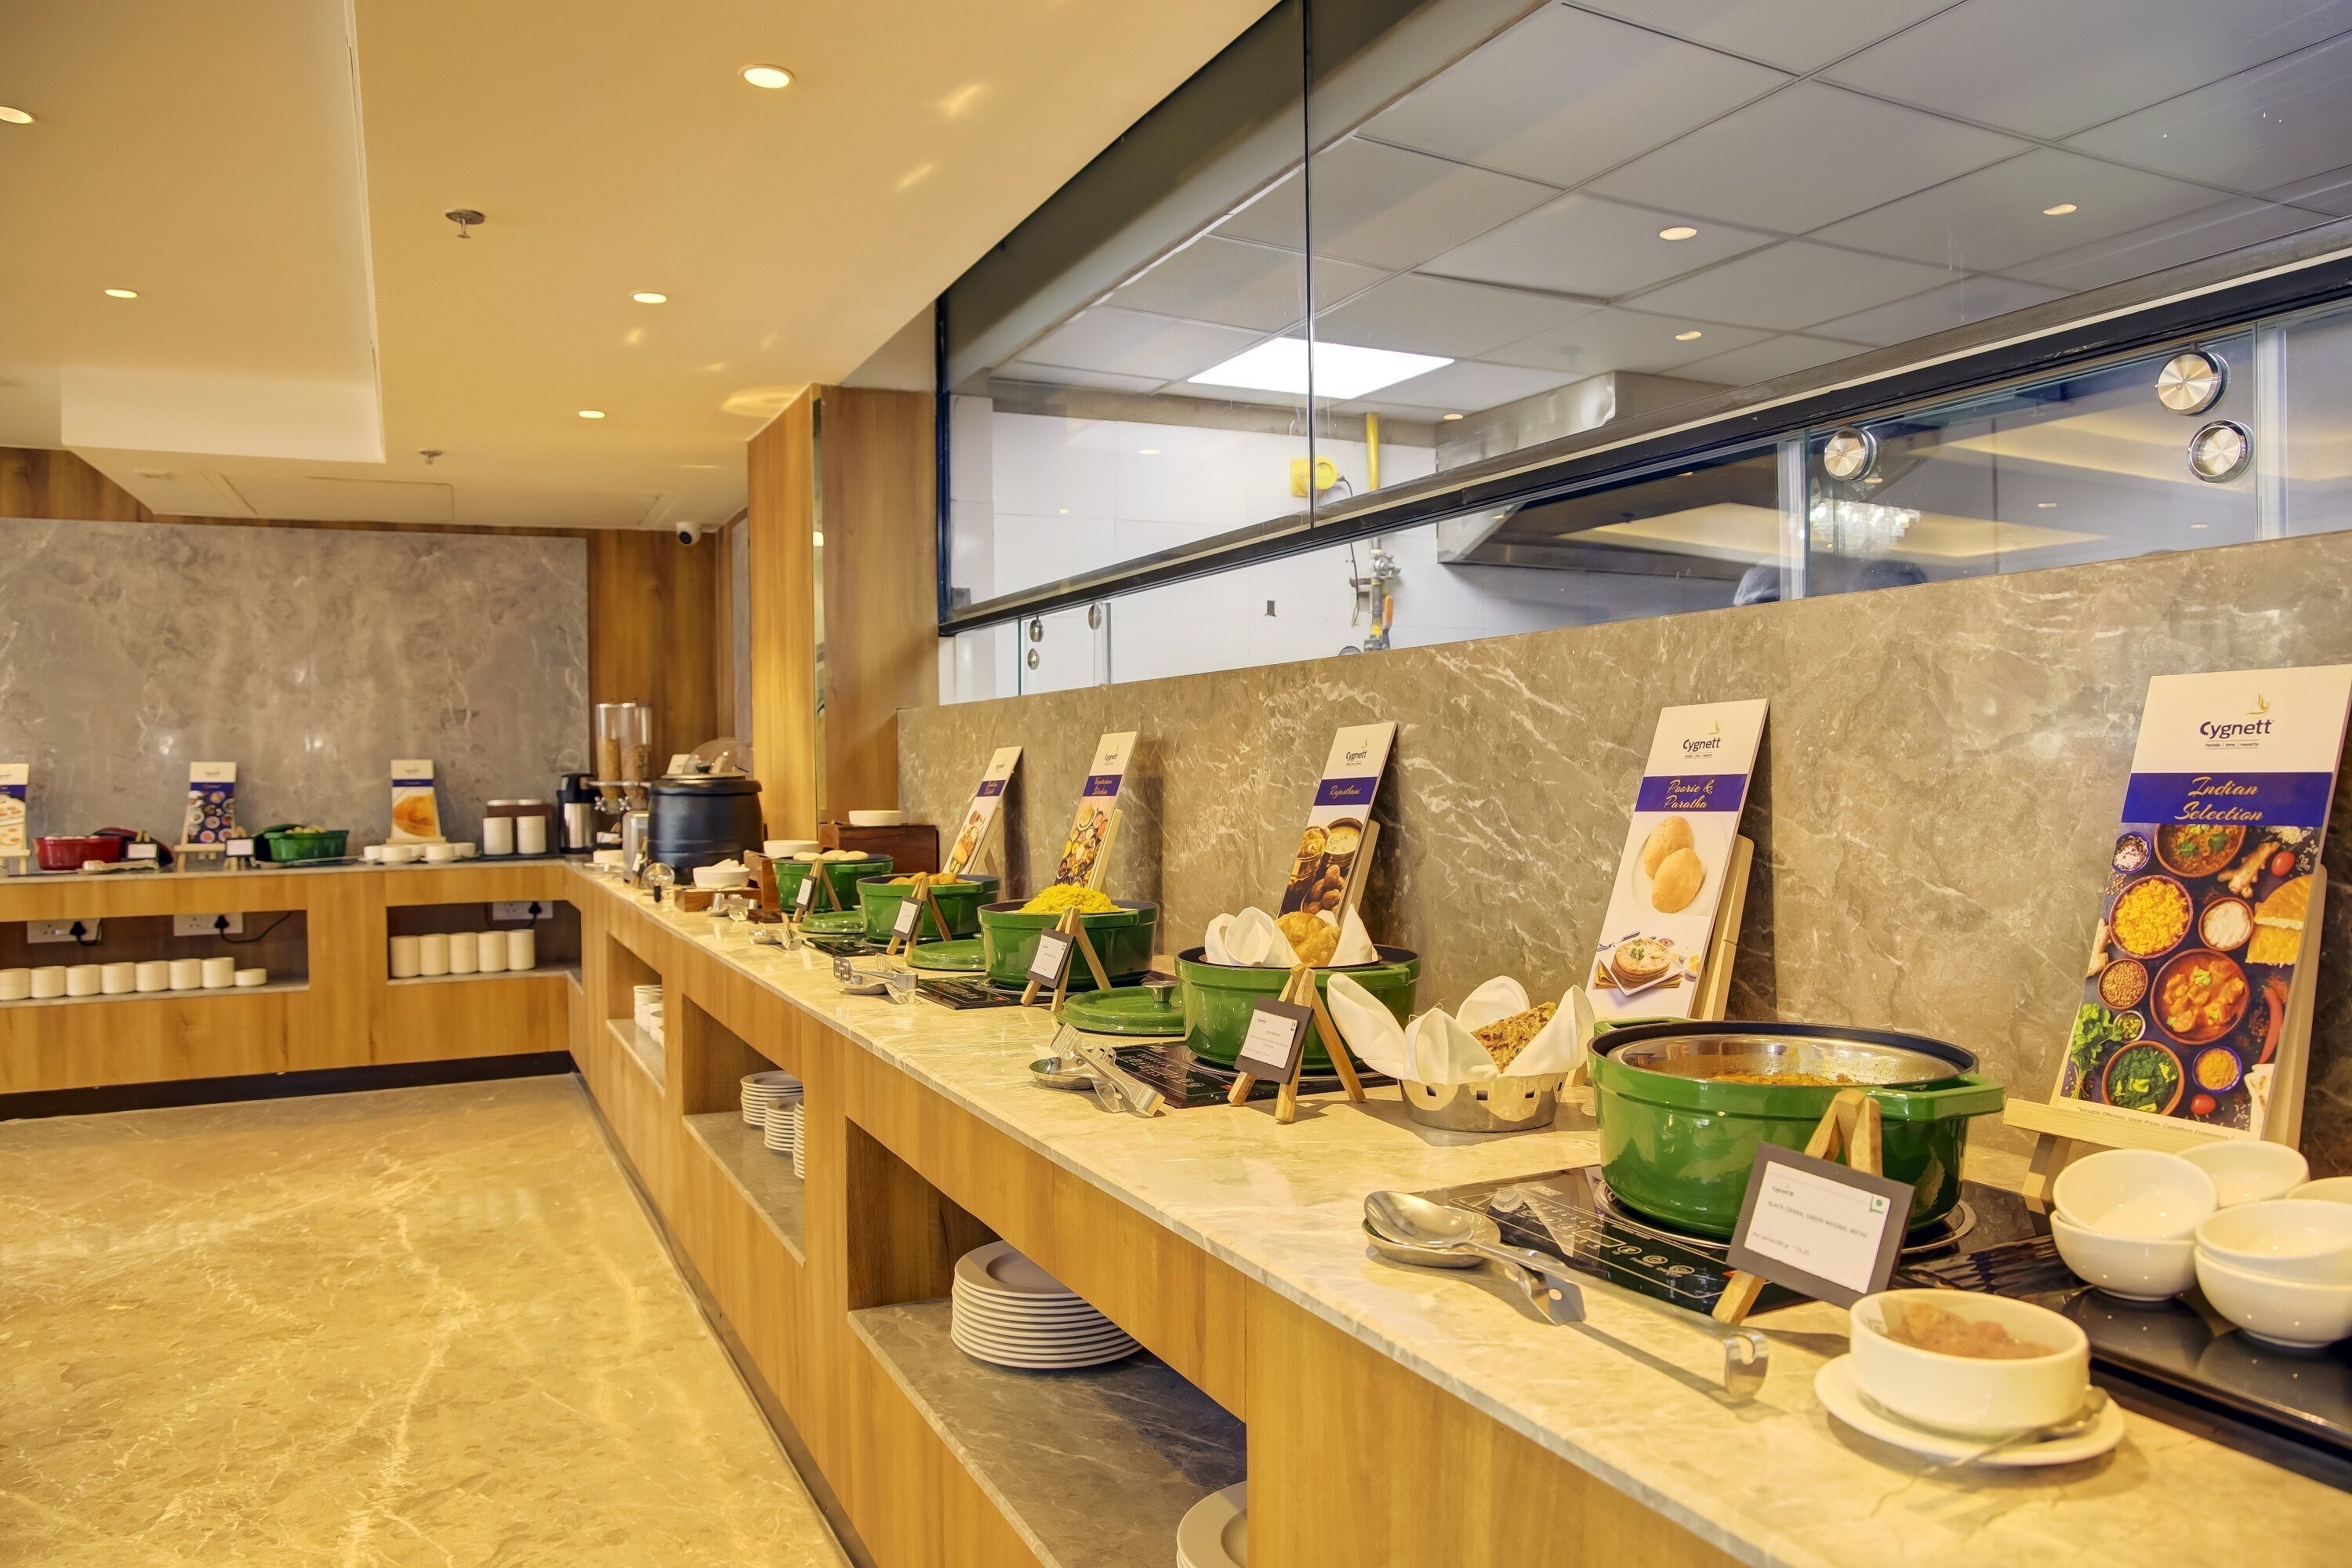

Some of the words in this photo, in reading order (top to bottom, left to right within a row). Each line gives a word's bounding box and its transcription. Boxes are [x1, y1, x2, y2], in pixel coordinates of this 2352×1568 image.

[2199, 719, 2273, 739] Cygnett
[1682, 737, 1722, 753] Cygnett
[1345, 750, 1367, 761] Cygnett
[1329, 785, 1362, 800] Rajasthani
[1667, 779, 1701, 793] Poorie
[1703, 779, 1714, 795] &
[2188, 776, 2259, 798] Indian
[1664, 795, 1709, 809] Paratha
[2174, 801, 2263, 822] Selection
